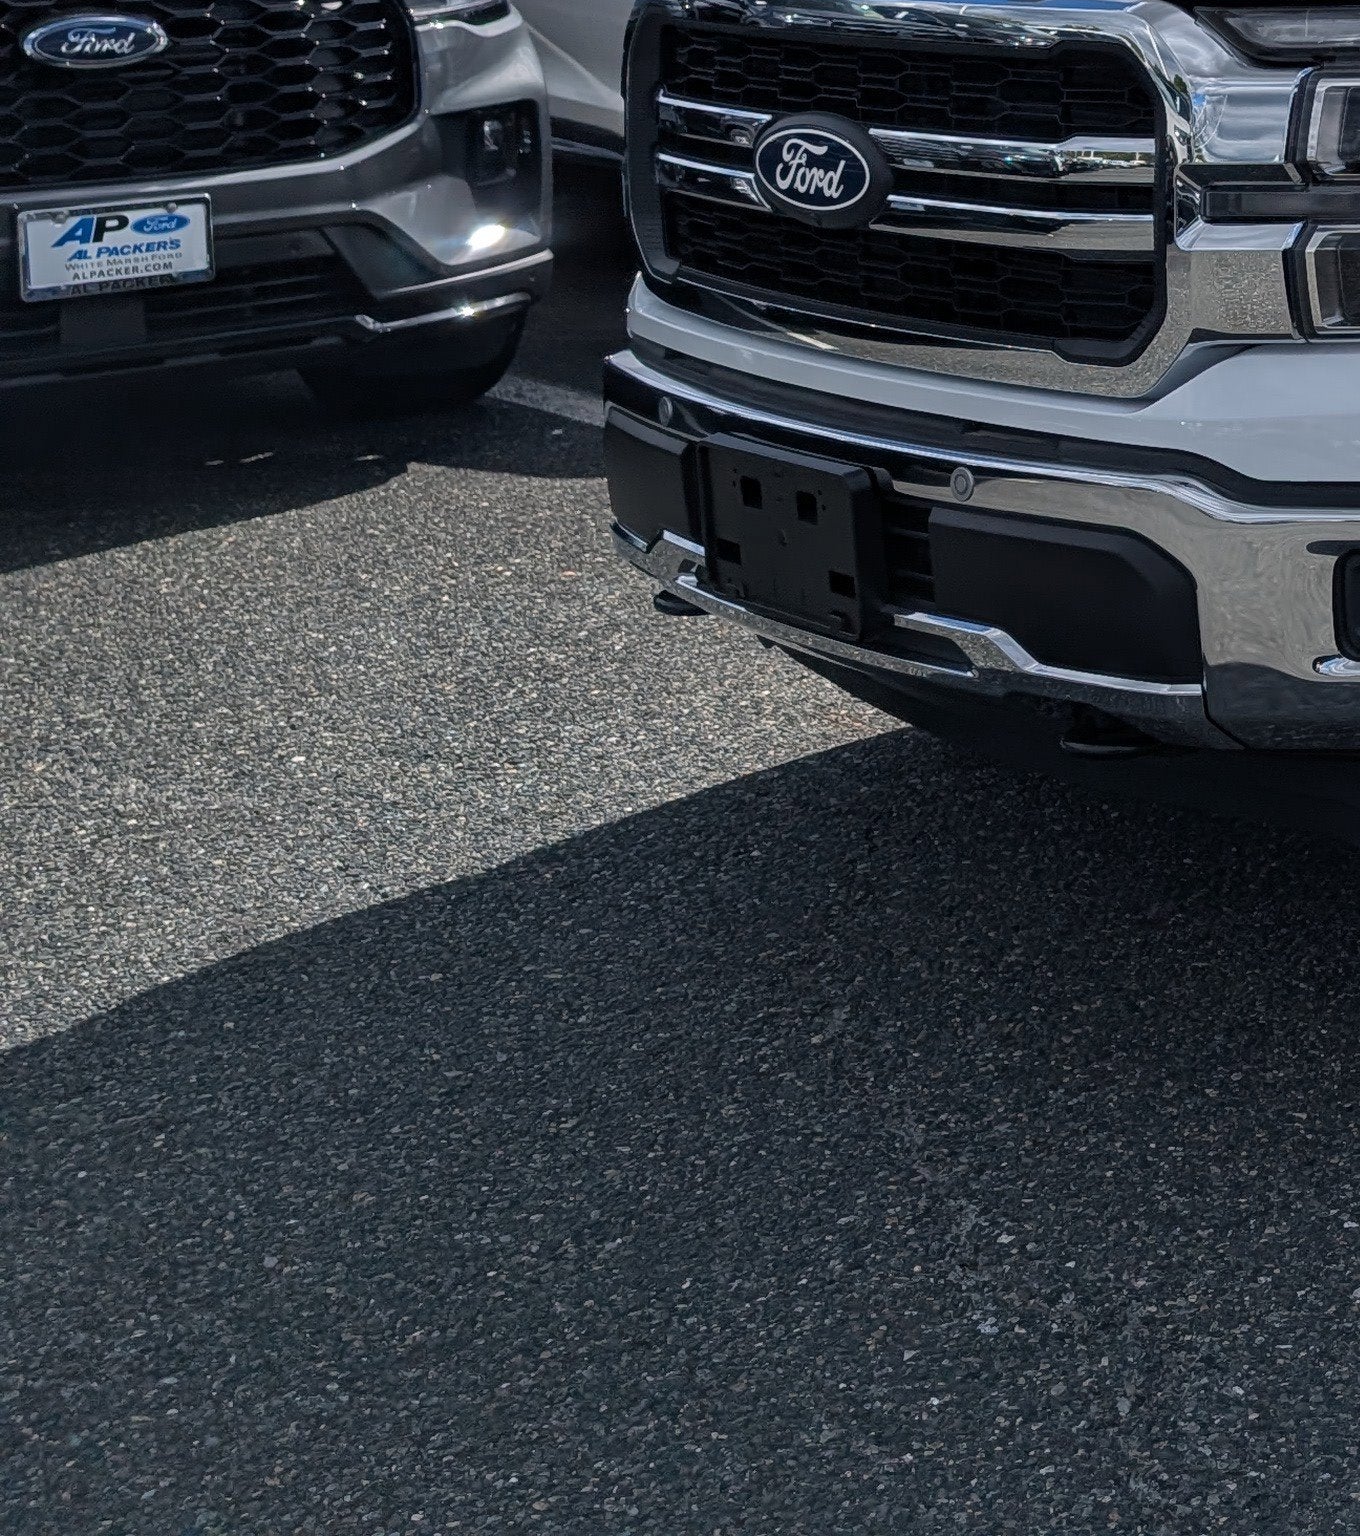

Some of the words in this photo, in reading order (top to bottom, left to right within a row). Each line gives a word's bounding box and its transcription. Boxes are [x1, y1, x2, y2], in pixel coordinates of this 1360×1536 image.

[60, 26, 136, 55] Ford
[775, 138, 846, 199] Ford
[51, 214, 130, 248] AP
[143, 215, 179, 233] Ford
[67, 248, 93, 262] AL
[72, 261, 174, 281] ALPACKER.COM
